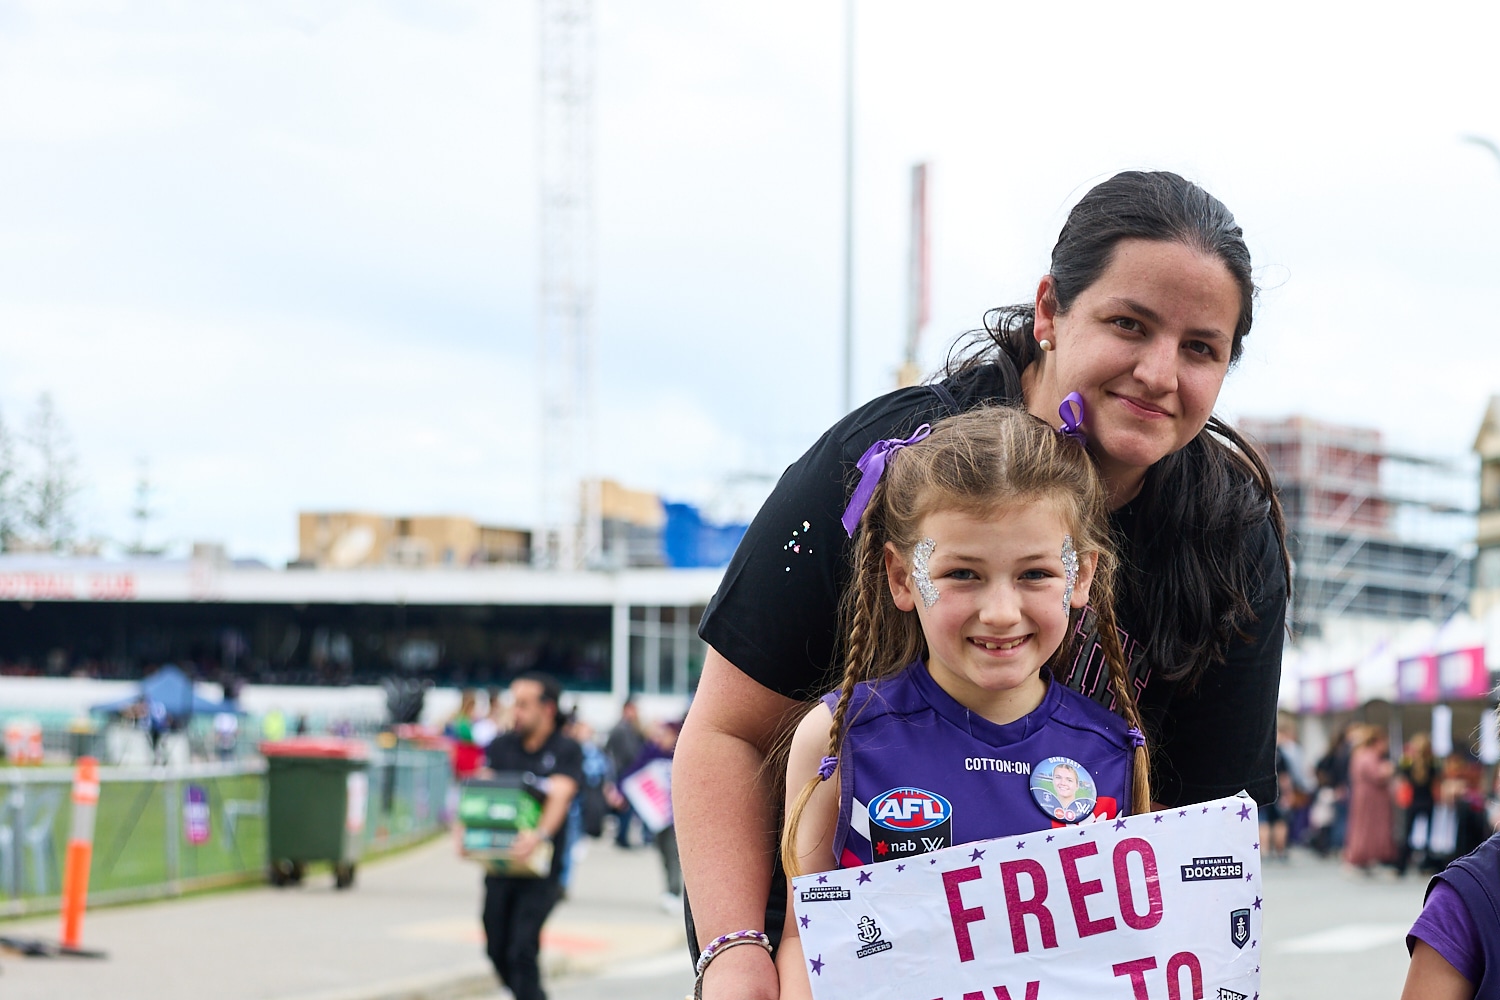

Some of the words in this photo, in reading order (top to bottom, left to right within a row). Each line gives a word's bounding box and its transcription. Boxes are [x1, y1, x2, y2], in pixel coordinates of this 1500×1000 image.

[964, 757, 1031, 775] COTTON:ON
[875, 798, 944, 820] AFL
[891, 837, 916, 852] nab
[1184, 865, 1241, 879] DOCKERS
[802, 891, 849, 900] DOCKERS
[940, 837, 1163, 963] FREO
[857, 942, 892, 958] DOCKERS
